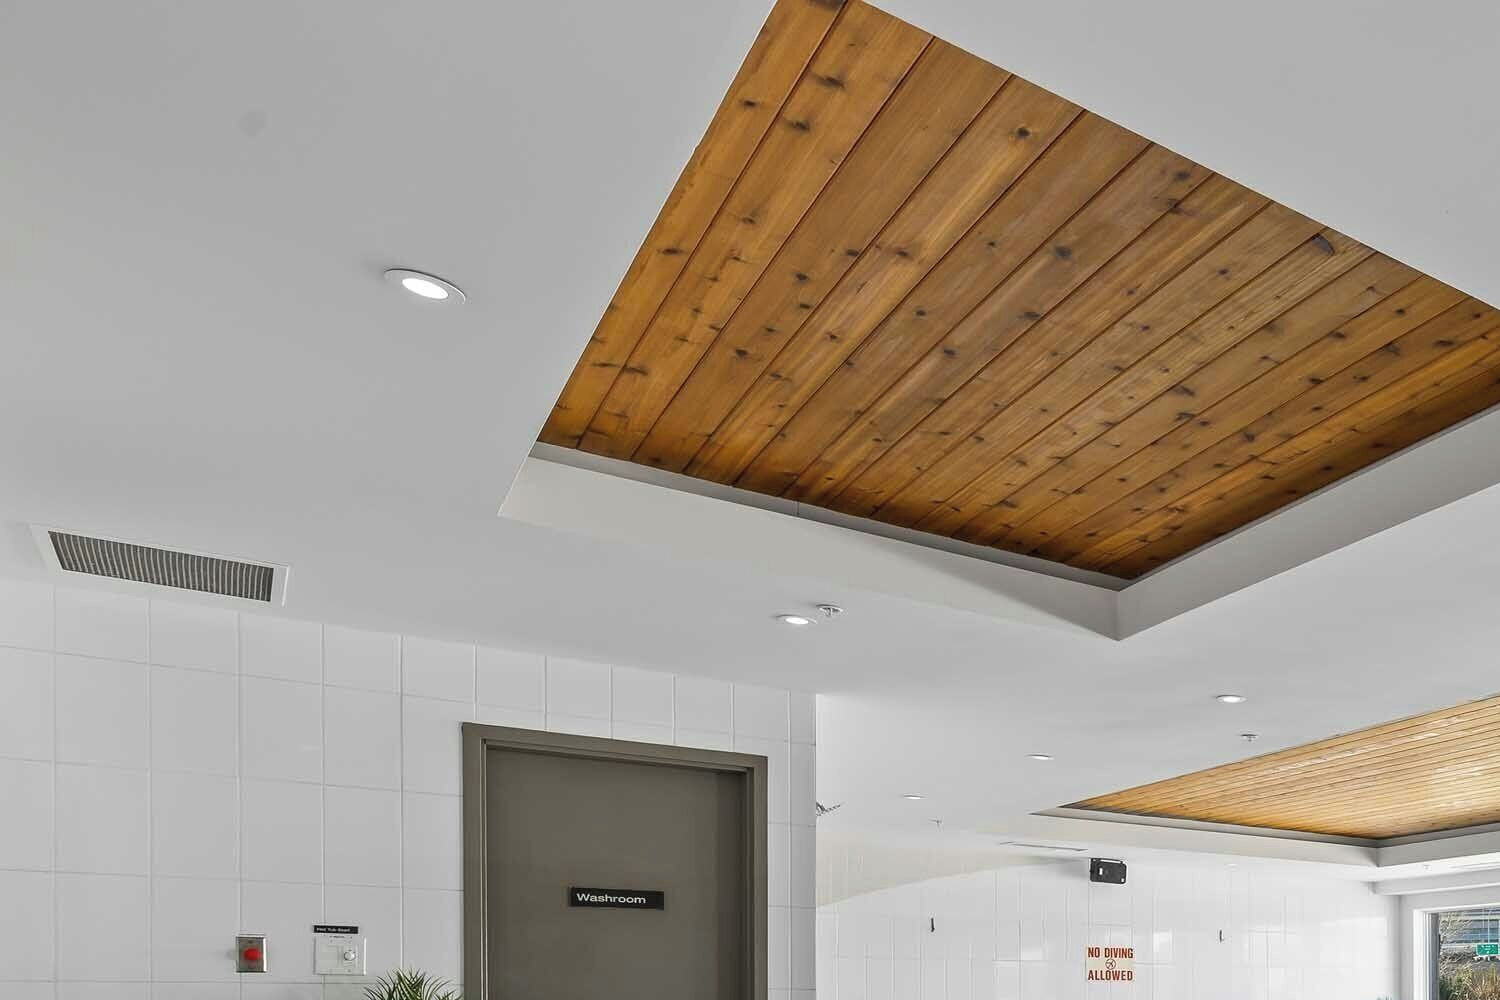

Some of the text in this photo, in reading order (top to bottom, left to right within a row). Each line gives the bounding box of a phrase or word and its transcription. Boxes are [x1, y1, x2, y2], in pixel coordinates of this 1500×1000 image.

[576, 893, 647, 904] Washroom
[1088, 947, 1133, 959] NO DIVING
[1087, 970, 1133, 981] ALLOWED
